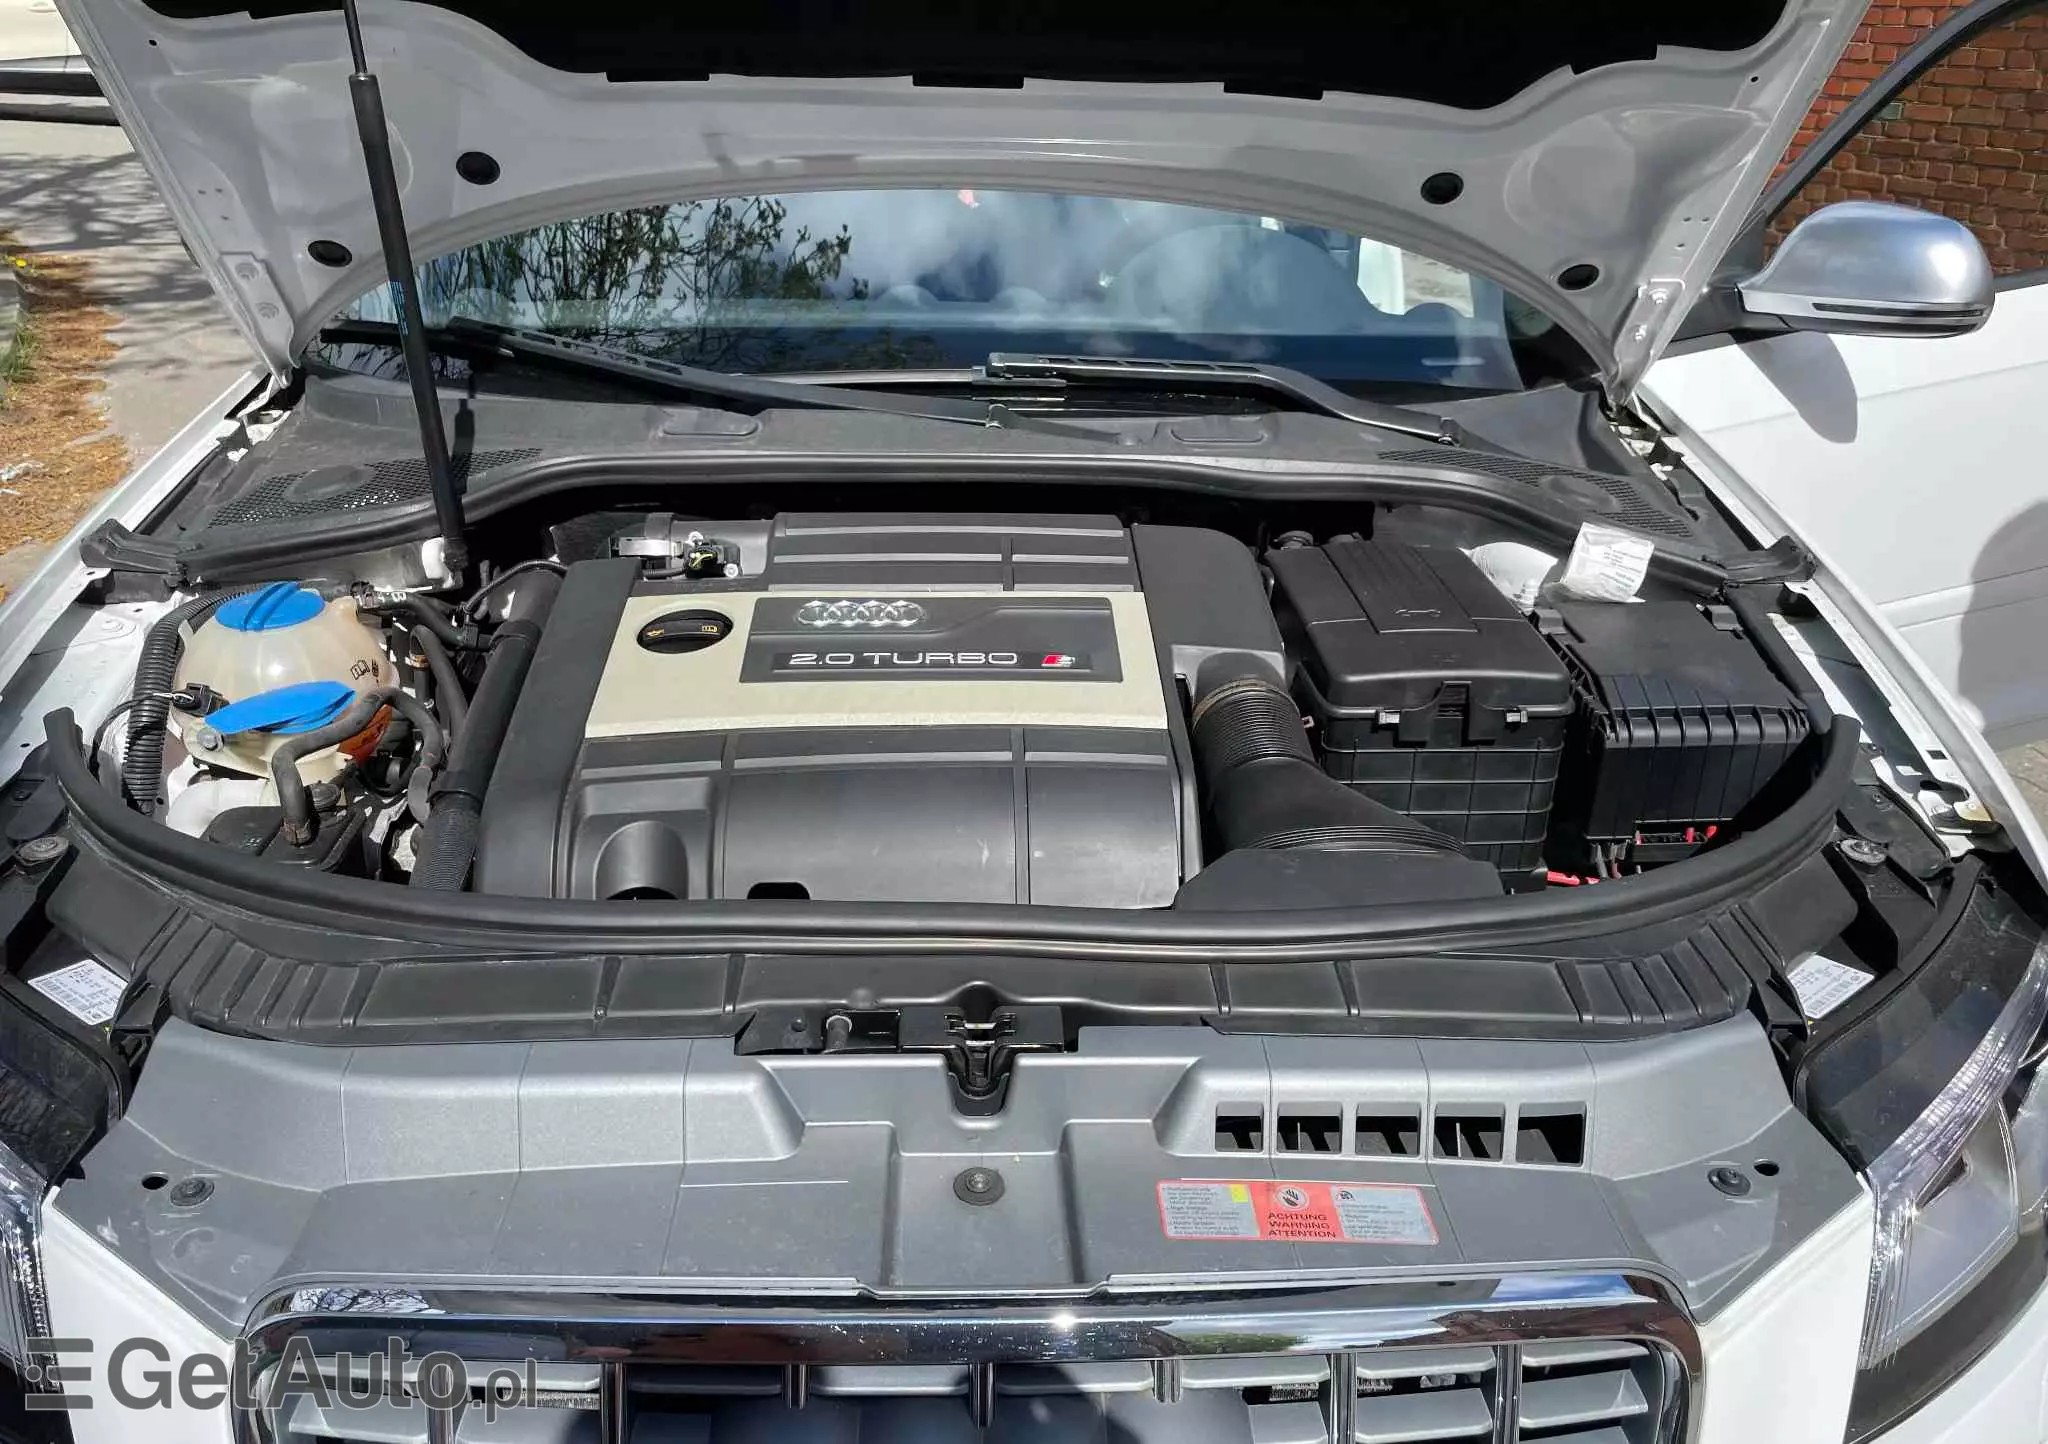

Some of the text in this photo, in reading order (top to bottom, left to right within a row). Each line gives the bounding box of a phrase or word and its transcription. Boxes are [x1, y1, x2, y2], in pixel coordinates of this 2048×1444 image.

[788, 652, 854, 665] 2.0
[863, 652, 1018, 665] TURBO
[1268, 1212, 1328, 1221] ACHTUNG
[1268, 1220, 1330, 1229] WARNING
[1268, 1229, 1336, 1238] ATTENTION
